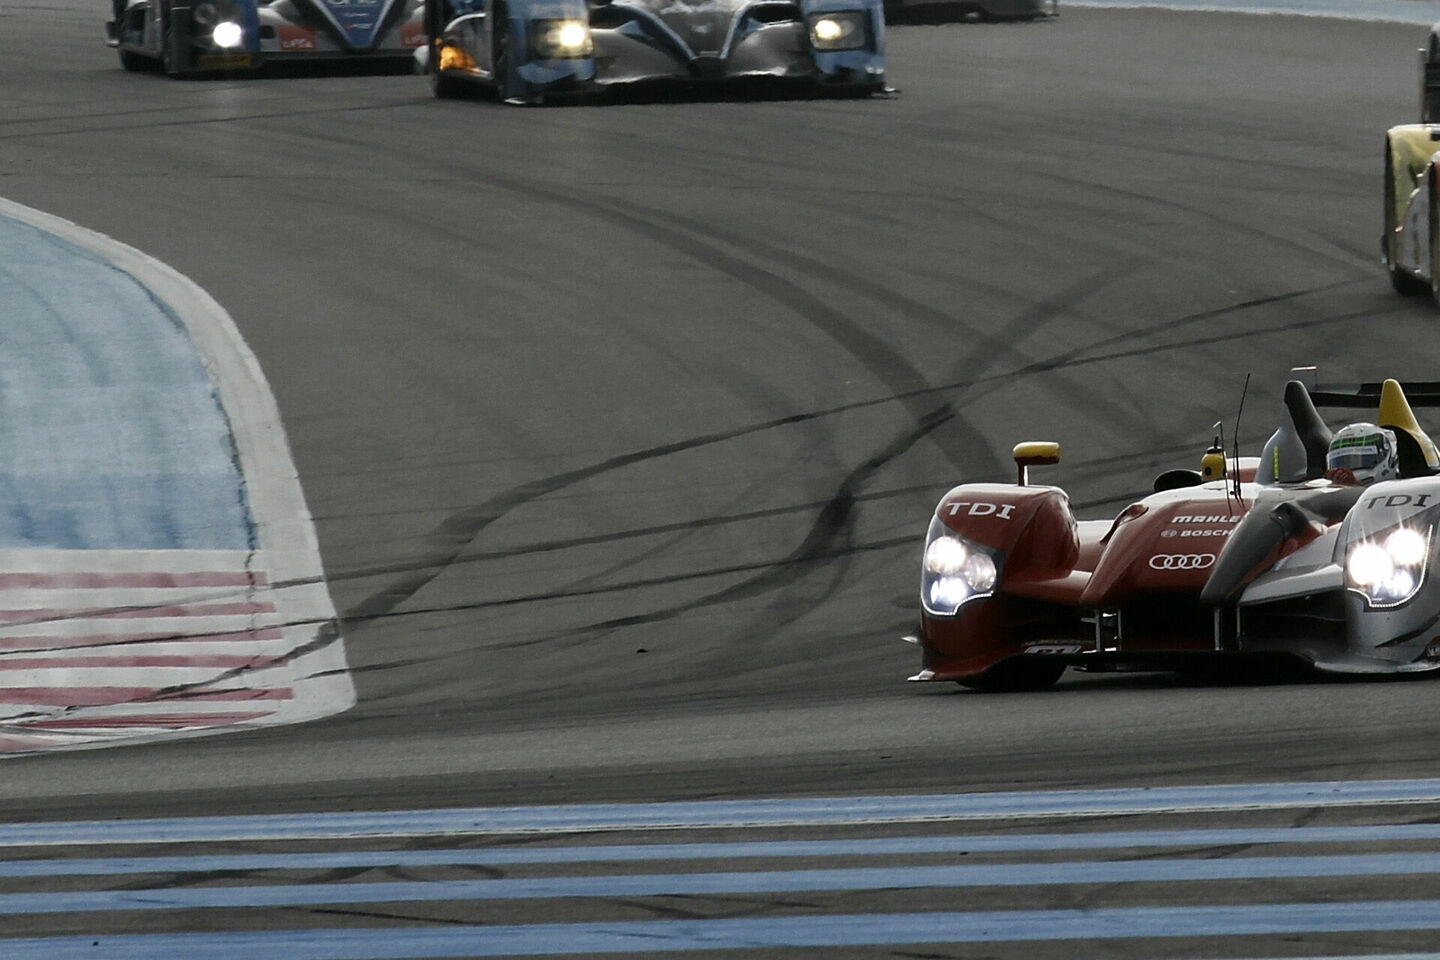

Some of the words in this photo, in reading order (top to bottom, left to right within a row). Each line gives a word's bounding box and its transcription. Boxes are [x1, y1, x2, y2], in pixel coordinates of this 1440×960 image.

[1363, 494, 1432, 510] TDI
[946, 502, 1016, 520] TDI
[1171, 515, 1242, 524] MAHLE
[1180, 529, 1233, 537] BOSCH
